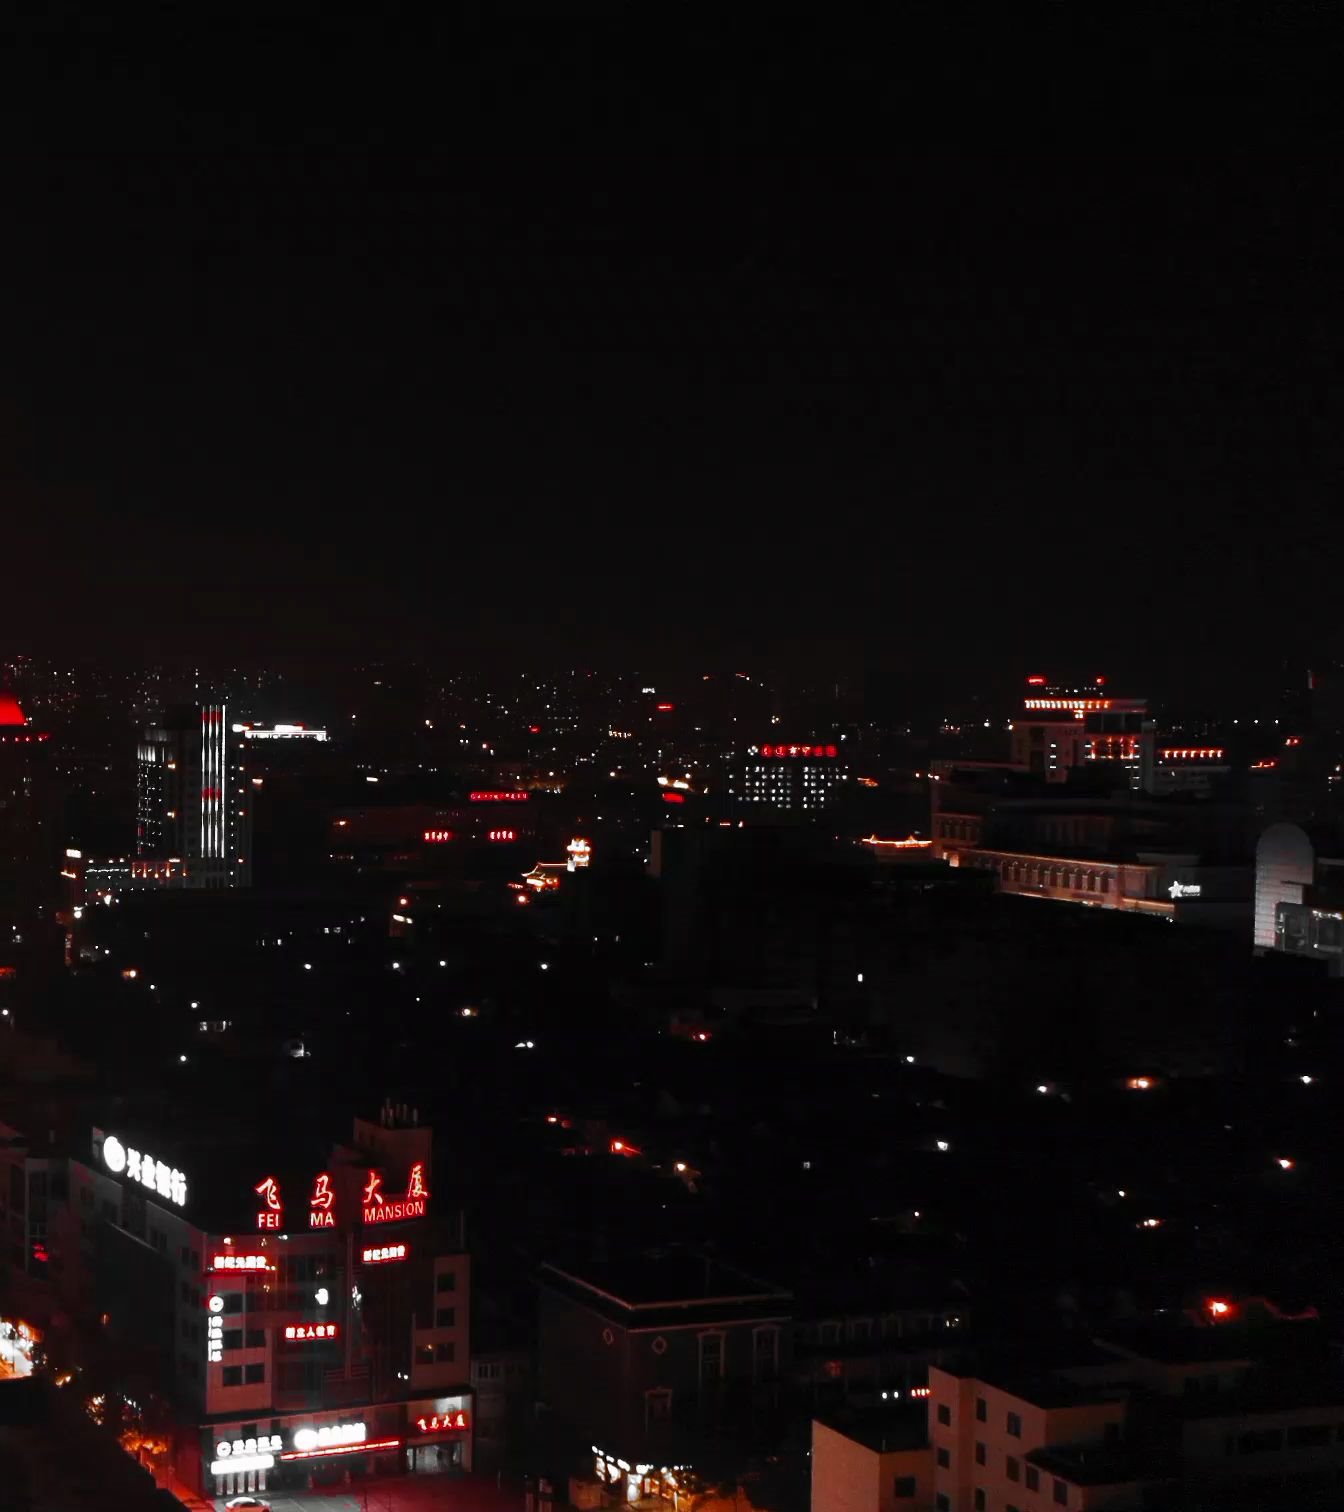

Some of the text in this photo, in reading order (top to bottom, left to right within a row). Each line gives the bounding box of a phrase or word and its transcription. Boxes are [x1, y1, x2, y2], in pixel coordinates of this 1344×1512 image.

[255, 1164, 428, 1210] 飞马大厦
[258, 1201, 425, 1229] FEI MA MANSION
